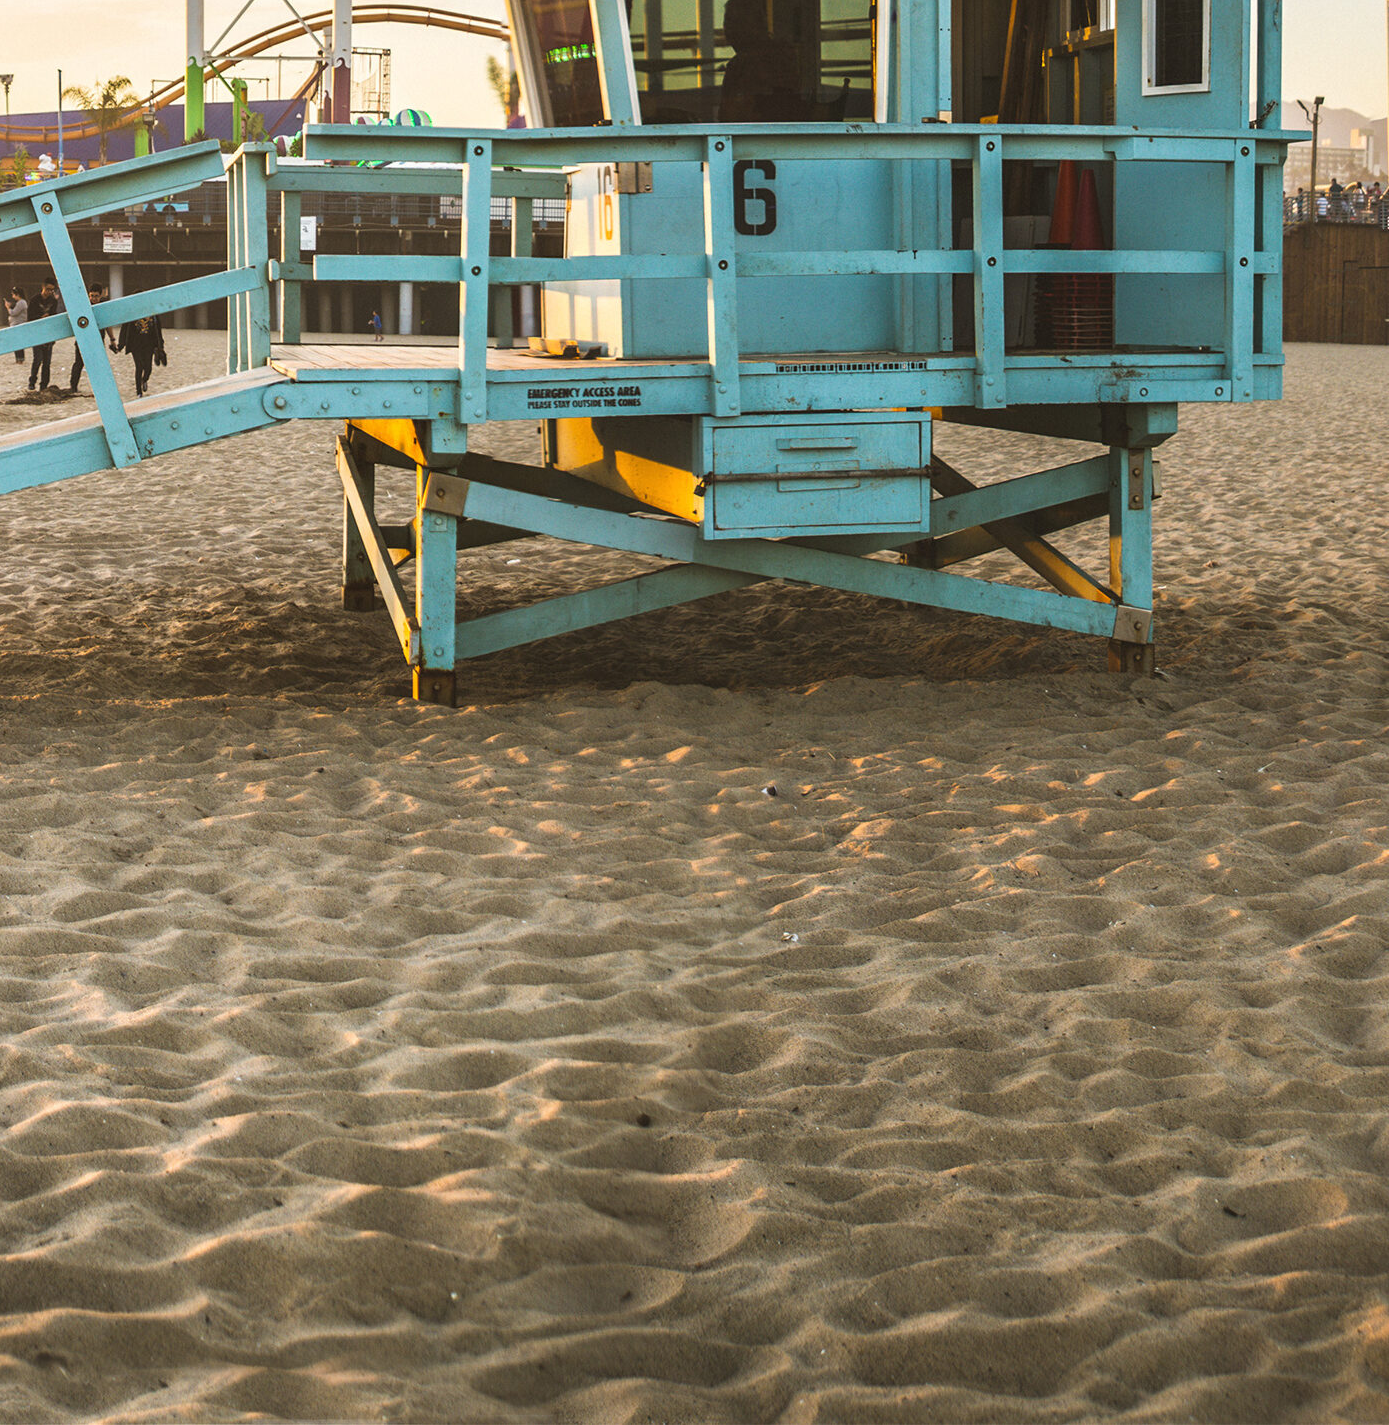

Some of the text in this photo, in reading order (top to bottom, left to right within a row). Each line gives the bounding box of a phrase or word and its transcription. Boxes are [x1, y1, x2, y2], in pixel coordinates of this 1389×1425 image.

[732, 159, 777, 236] 6
[527, 386, 641, 399] EMERGENCY ACCESS AREA
[527, 398, 641, 409] PLEASE STAY OUTSIDE THE CONES
